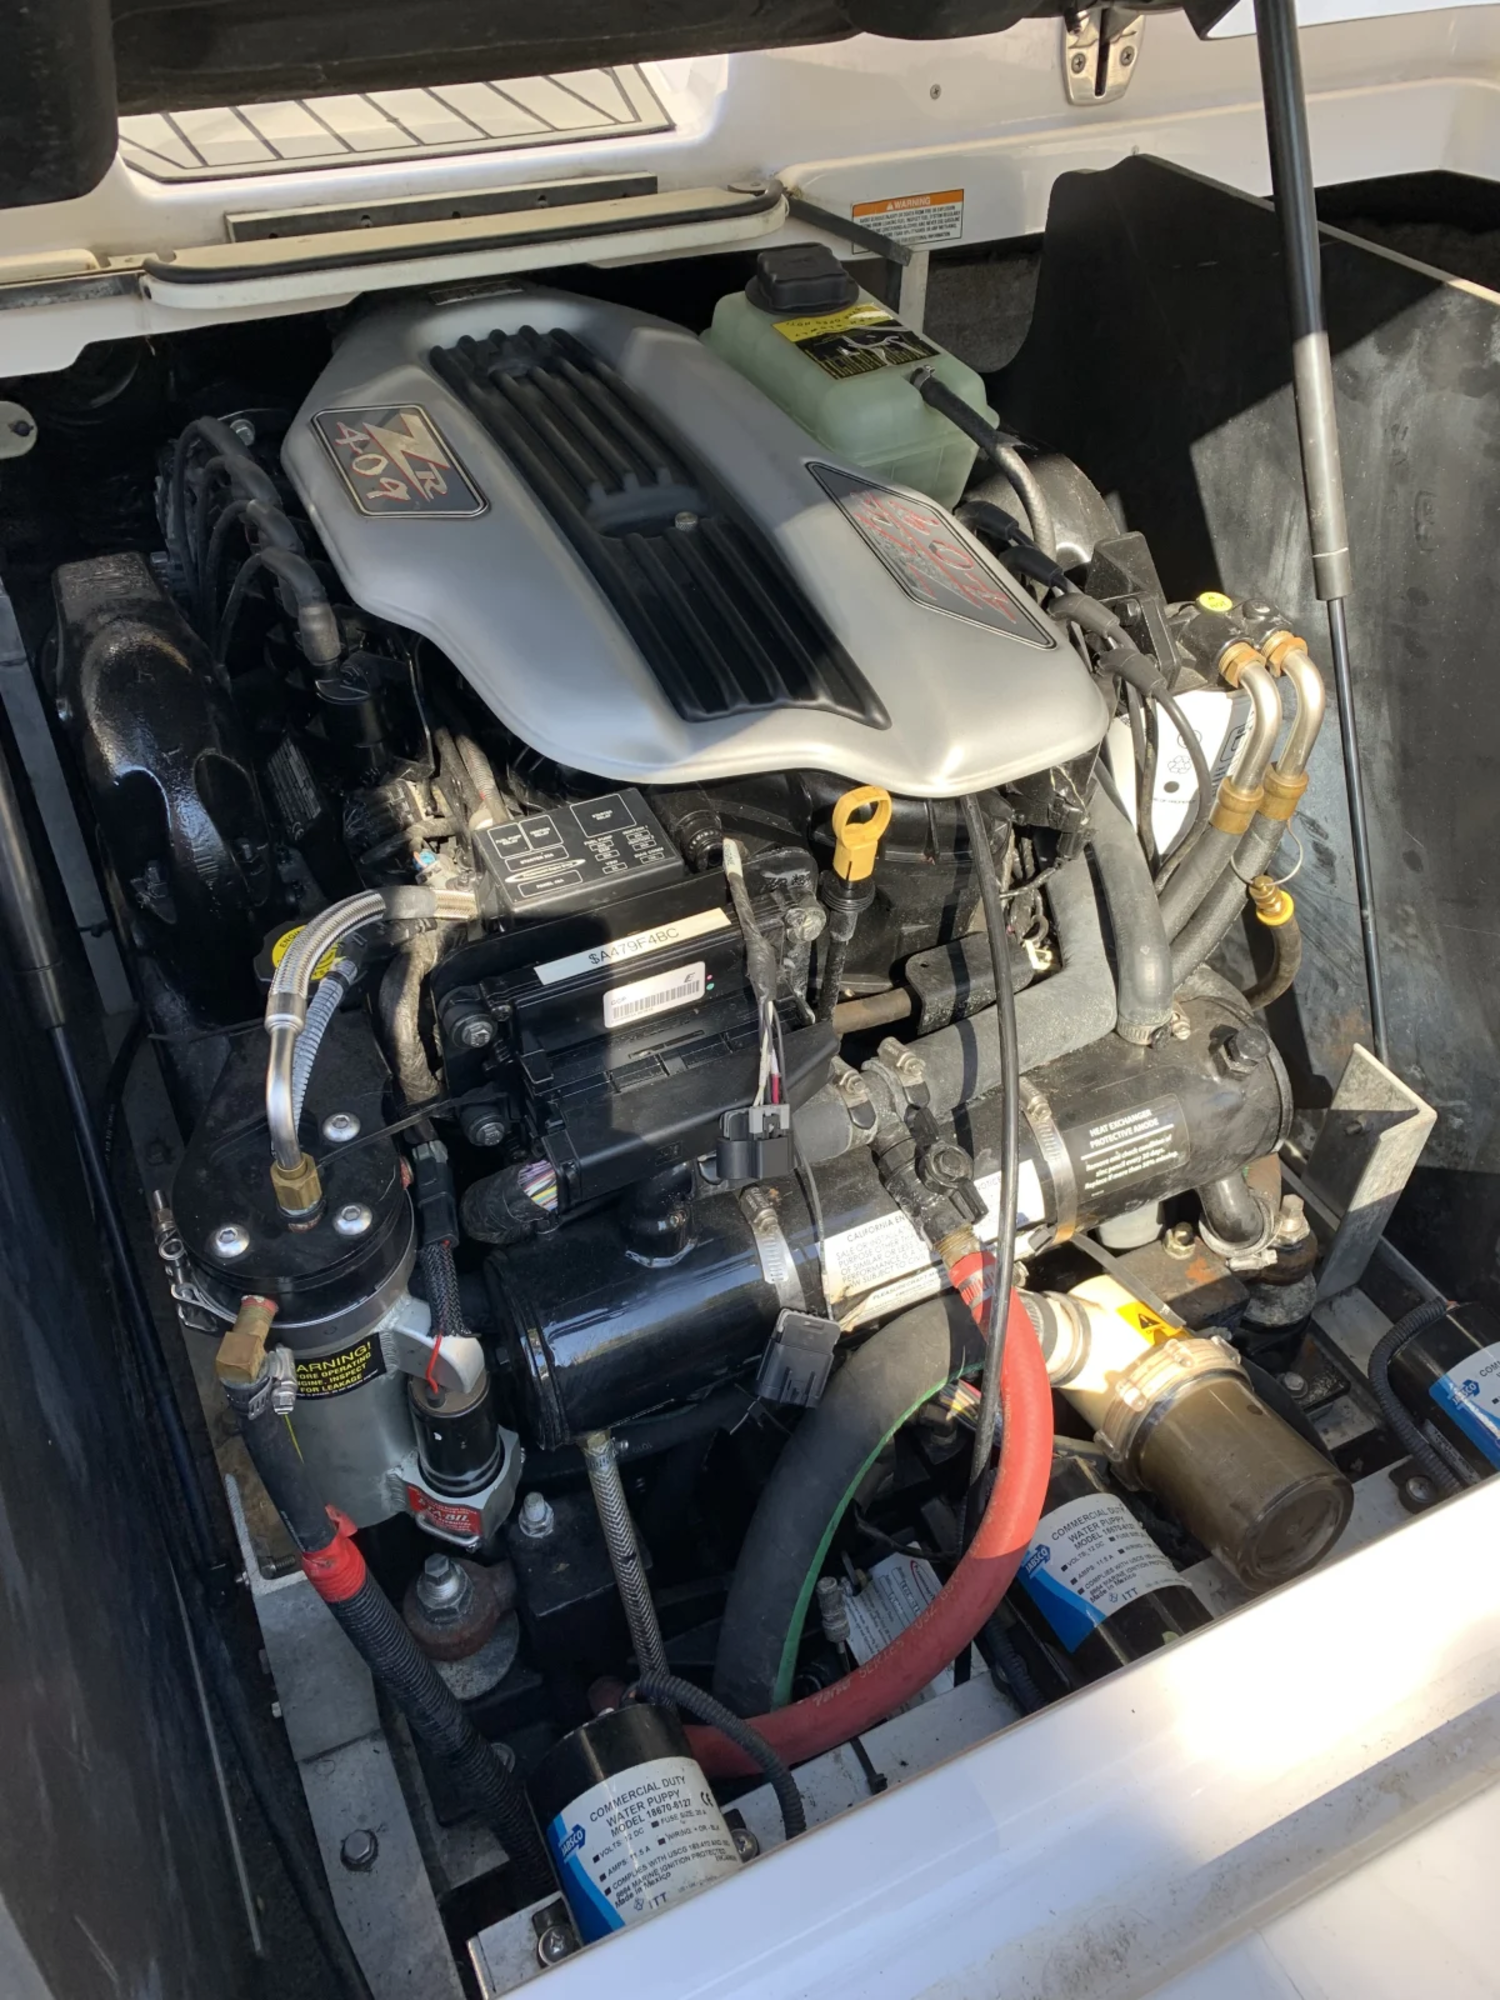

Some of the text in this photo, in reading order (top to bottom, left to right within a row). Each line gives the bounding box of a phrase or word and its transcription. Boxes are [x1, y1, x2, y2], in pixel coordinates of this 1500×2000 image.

[893, 197, 930, 209] WARNING
[588, 928, 679, 965] $A479F4BC
[1090, 1109, 1152, 1137] HEAT EXCHANGER
[1090, 1118, 1159, 1149] PROTECTIVE ANODE
[847, 1217, 894, 1243] CALIFORNIA
[838, 1247, 874, 1268] PURPOSE
[840, 1265, 852, 1276] OF
[852, 1252, 883, 1271] SIMILAR
[842, 1254, 901, 1283] PERFORMANCE
[862, 1265, 892, 1283] SUBJECT
[297, 1341, 371, 1372] ARNING!
[322, 1352, 371, 1377] OPERATING
[322, 1374, 362, 1391] LEAKAGE
[330, 1363, 366, 1383] INSPECT
[1051, 1508, 1108, 1541] COMMERCIAL
[1068, 1521, 1101, 1543] WATER
[1074, 1531, 1103, 1550] MODEL
[1025, 1547, 1048, 1574] JABSCO
[1084, 1567, 1114, 1589] COMPLIES
[1089, 1590, 1107, 1603] Made
[1122, 1587, 1138, 1600] ITT
[590, 1776, 686, 1822] COMMERCIAL DUTY
[606, 1789, 680, 1827] WATER PUPPY
[610, 1799, 691, 1838] MODEL 18670-6127
[660, 1813, 679, 1825] FUSE
[561, 1830, 584, 1856] JABSCO
[633, 1827, 645, 1837] DC
[612, 1863, 648, 1890] COMPLIES
[648, 1855, 667, 1868] WITH
[668, 1846, 688, 1859] USCG
[632, 1867, 659, 1887] MARINE
[660, 1854, 691, 1874] IGNITION
[691, 1848, 726, 1859] PROTECTED
[614, 1892, 634, 1909] Made
[643, 1872, 671, 1889] Mexico
[648, 1892, 667, 1908] ITT
